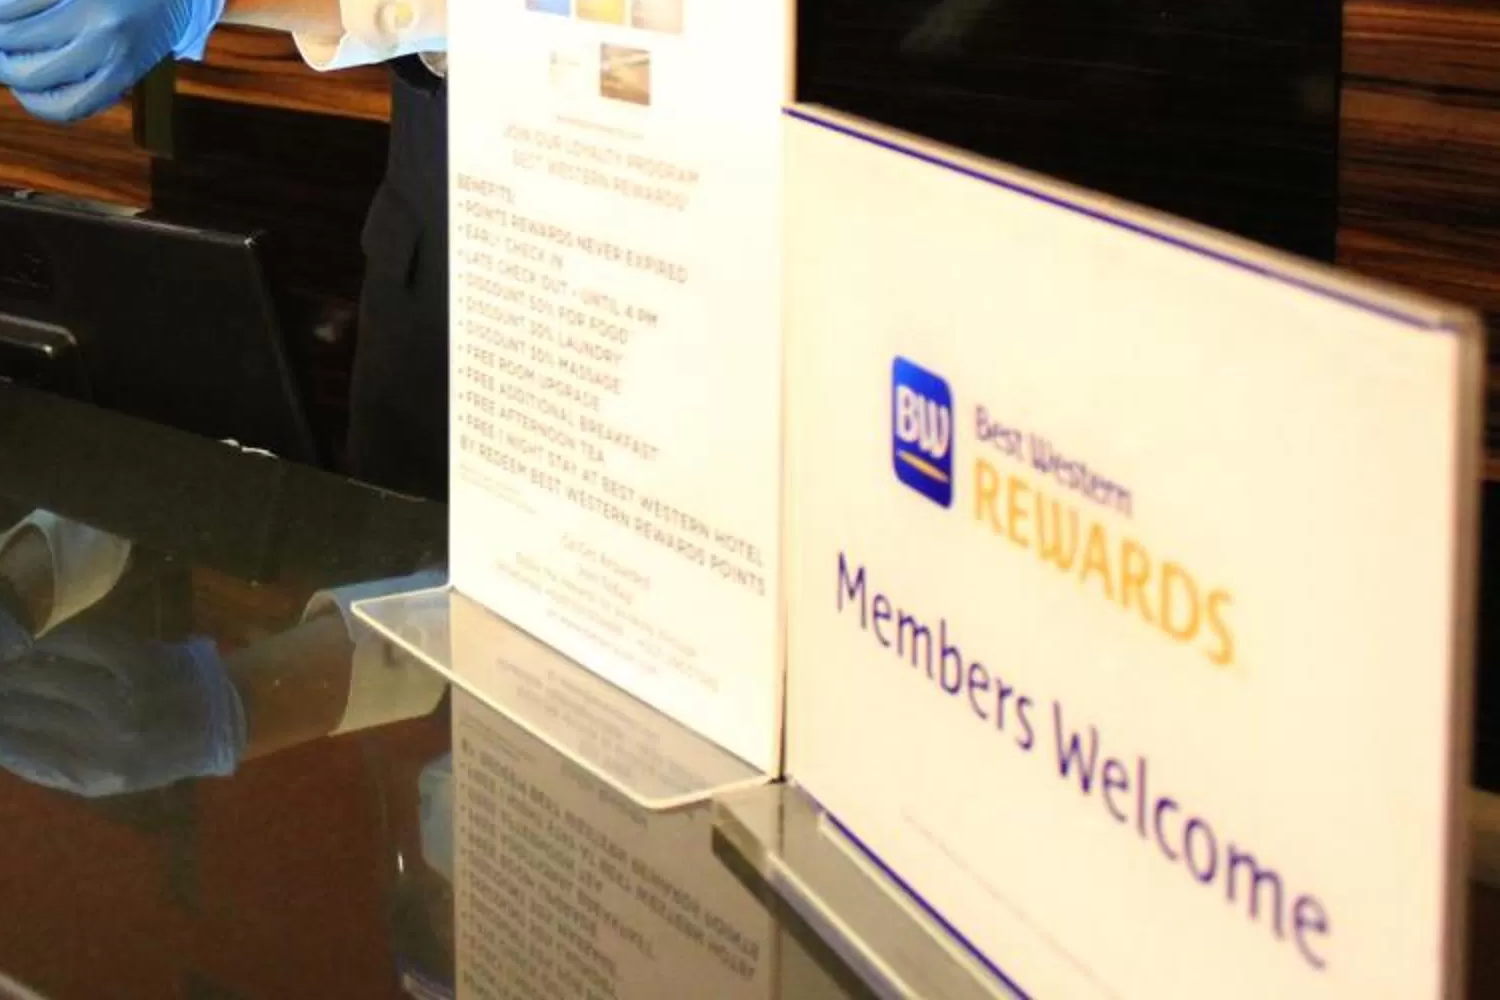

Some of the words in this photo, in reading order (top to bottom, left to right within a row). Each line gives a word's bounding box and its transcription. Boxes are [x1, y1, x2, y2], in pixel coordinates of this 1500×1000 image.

[498, 258, 536, 284] CHECK
[504, 237, 544, 262] CHECK
[576, 235, 622, 261] NEVER
[626, 248, 689, 284] EXPIRED
[466, 344, 496, 368] FREE
[499, 356, 535, 381] ROOM
[466, 366, 496, 391] FREE
[499, 382, 575, 427] ADDITIONAL
[580, 414, 661, 460] BREAKFAST
[466, 390, 496, 417] FREE
[499, 407, 576, 449] AFTERNOON
[580, 439, 604, 462] TEA
[896, 384, 950, 459] BW
[466, 413, 495, 440] FREE
[601, 475, 635, 501] BEST
[639, 496, 709, 540] WESTERN
[715, 527, 763, 568] HOTEL
[974, 403, 1025, 457] Best
[1029, 437, 1134, 520] Western
[529, 467, 561, 496] BEST
[566, 487, 630, 529] WESTERN
[633, 515, 706, 567] REWARDS
[710, 552, 765, 597] POINTS
[971, 455, 1236, 667] REWARDS
[836, 550, 1036, 753] Members
[1051, 700, 1329, 971] Welcome
